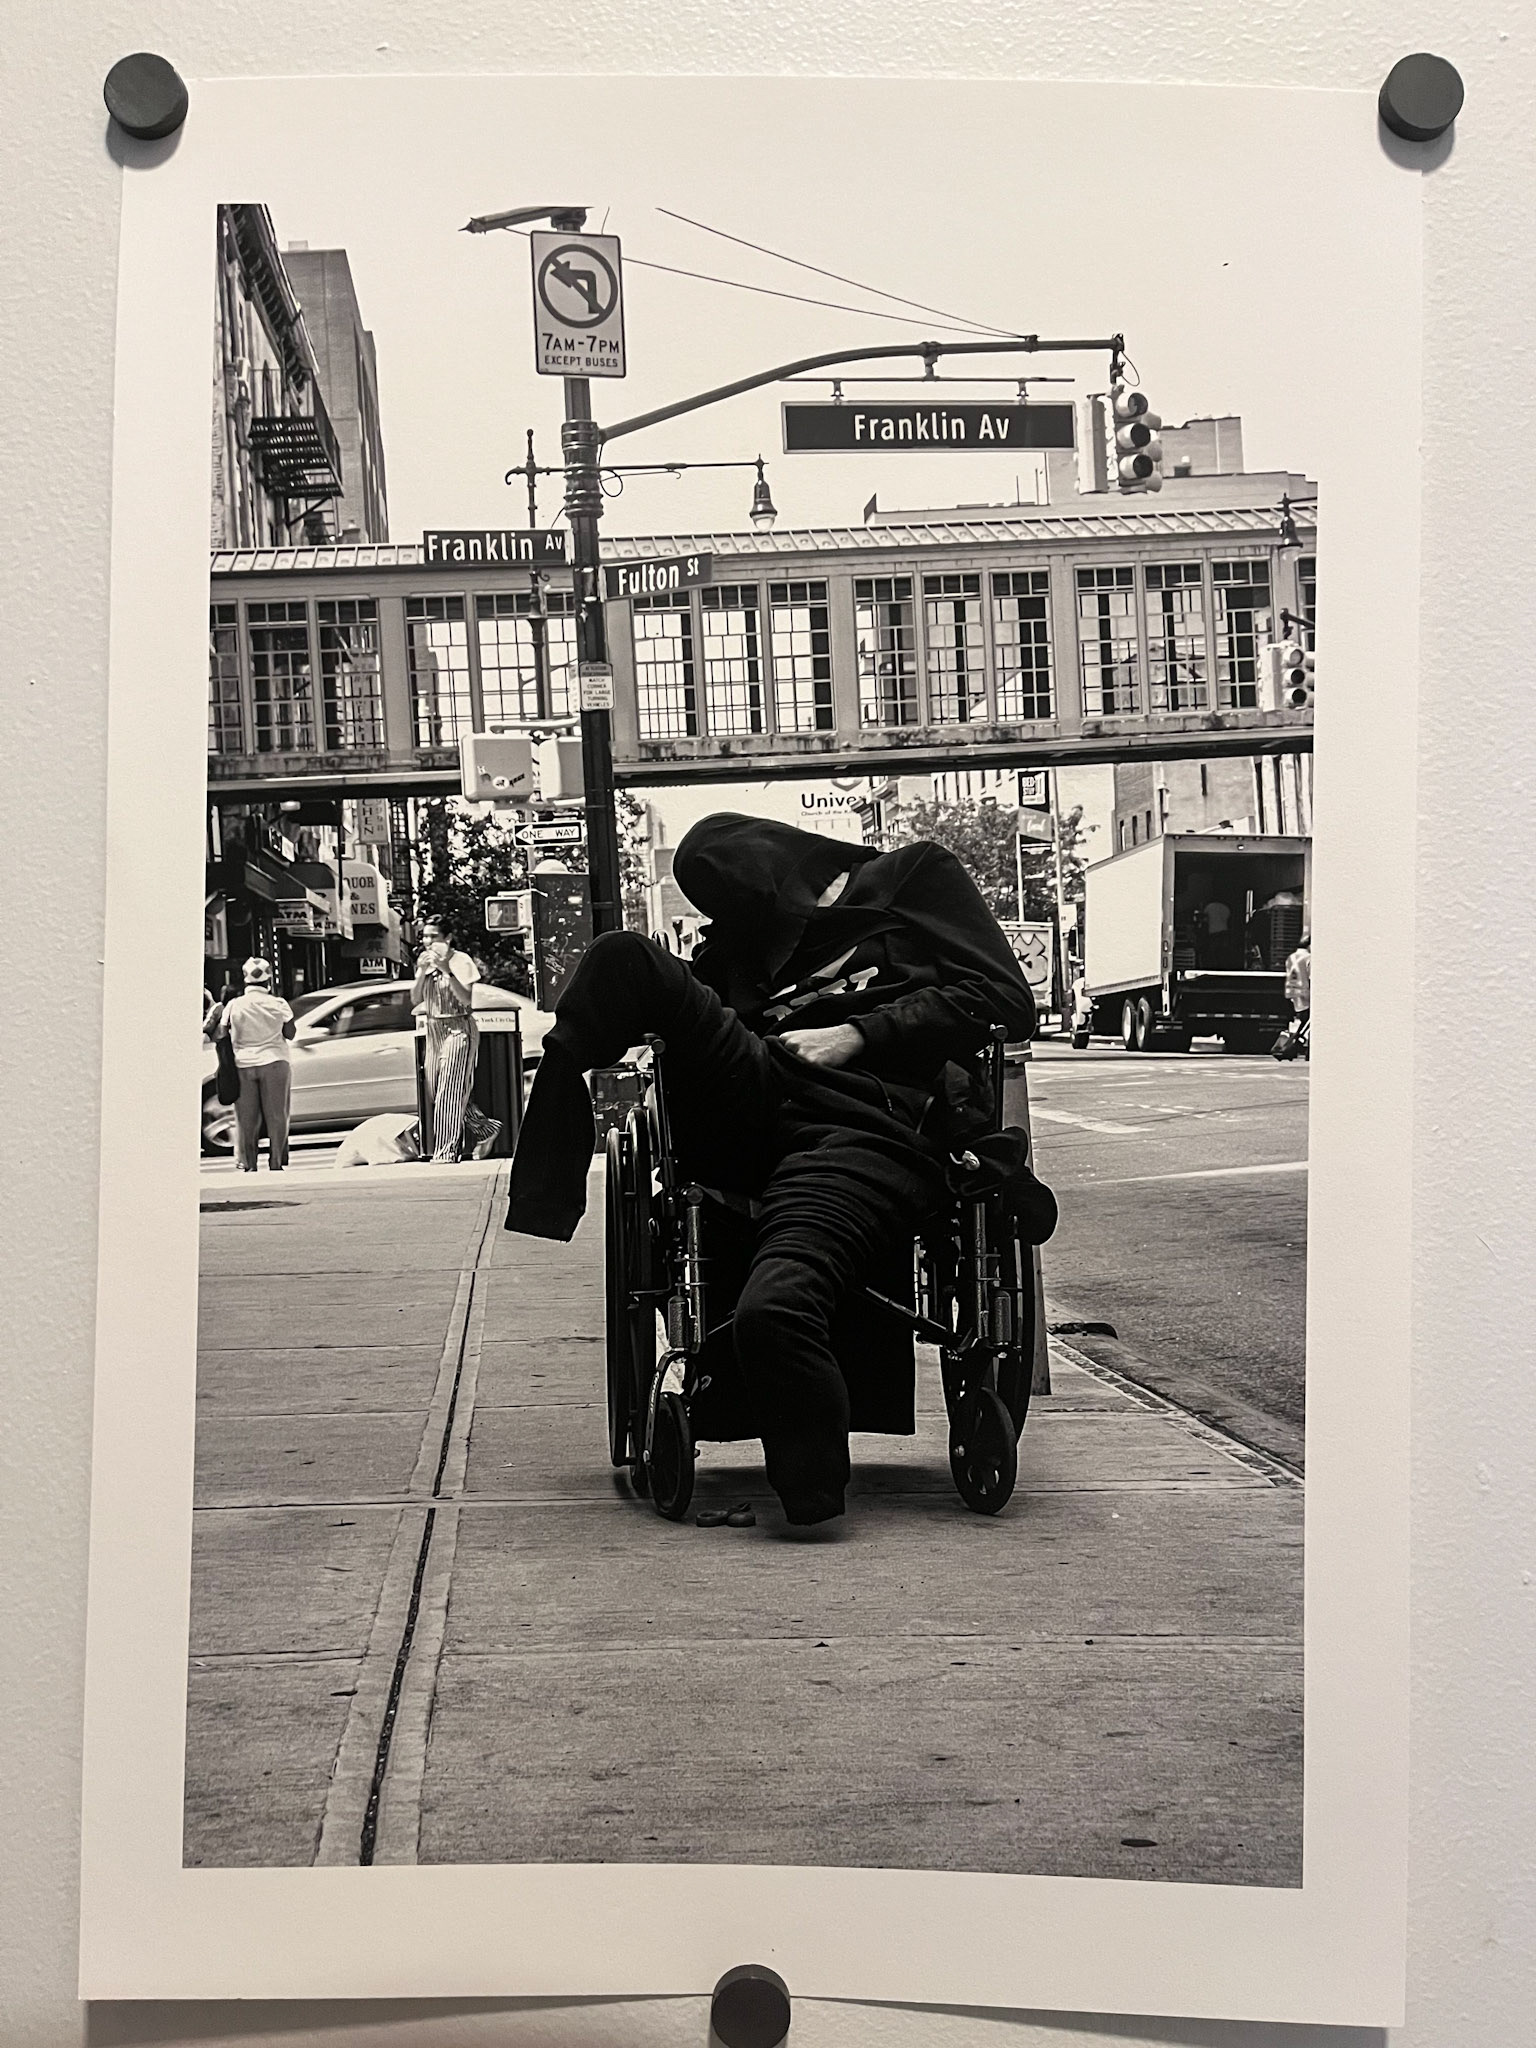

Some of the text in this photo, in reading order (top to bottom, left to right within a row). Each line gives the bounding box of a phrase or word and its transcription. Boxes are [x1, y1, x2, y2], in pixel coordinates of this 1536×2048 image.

[542, 333, 620, 354] 7AM-7PM
[544, 355, 618, 368] EXCEPT BUSES
[854, 412, 1010, 441] Franklin Av
[427, 532, 563, 561] Franklin Av
[618, 556, 699, 596] Fulton St
[521, 829, 576, 840] ONE WAY
[362, 957, 385, 968] ATM
